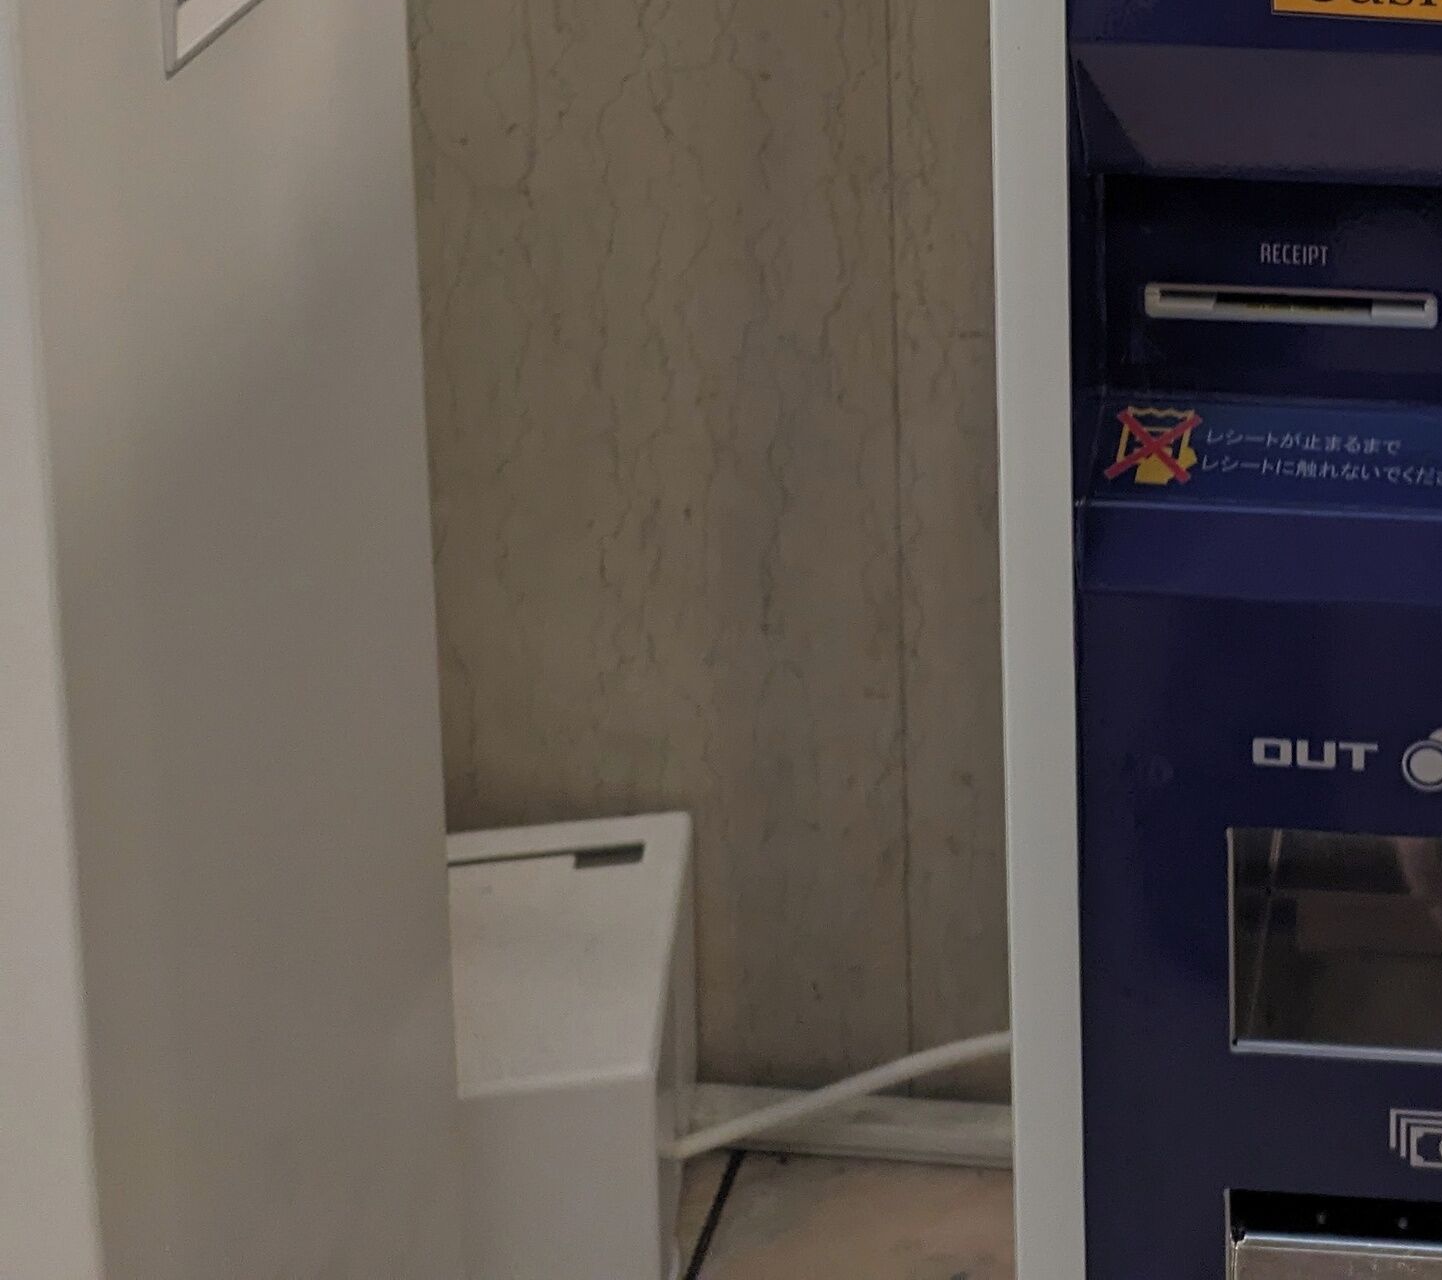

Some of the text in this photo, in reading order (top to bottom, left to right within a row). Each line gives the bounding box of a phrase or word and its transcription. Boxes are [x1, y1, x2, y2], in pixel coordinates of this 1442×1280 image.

[1260, 243, 1329, 266] RECEIPT
[1206, 429, 1402, 456] レシートが止まるまで
[1252, 737, 1378, 772] OUT
